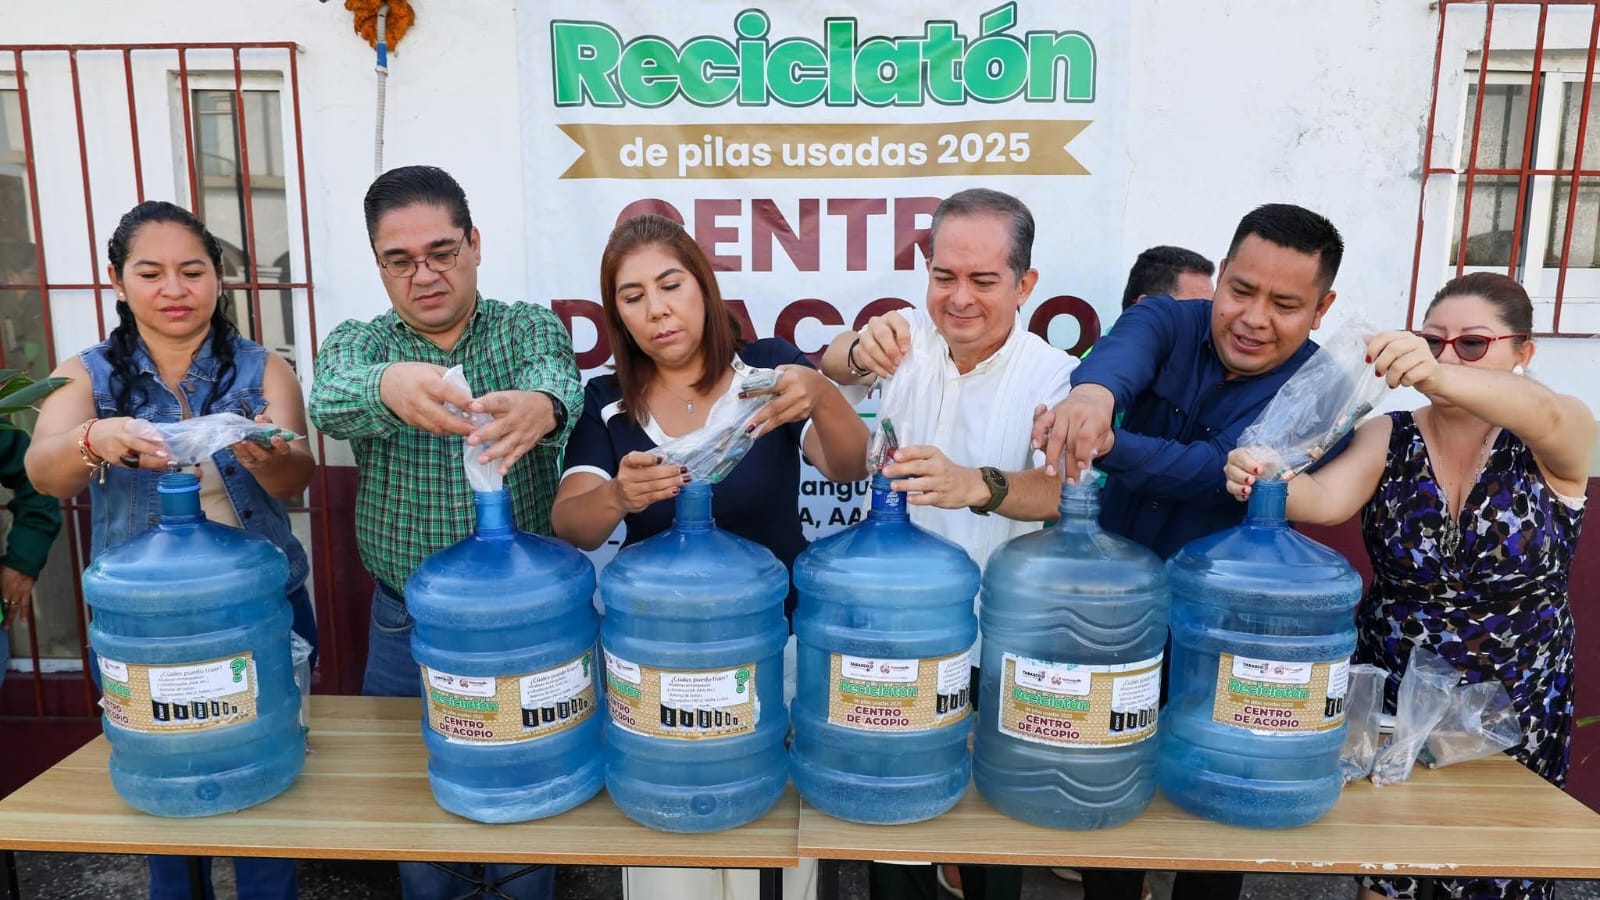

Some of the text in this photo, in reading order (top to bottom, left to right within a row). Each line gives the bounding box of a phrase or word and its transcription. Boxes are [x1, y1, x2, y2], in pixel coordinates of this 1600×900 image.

[550, 1, 1098, 108] Reciclatón
[619, 131, 1031, 177] de pilas usadas 2025
[615, 197, 944, 272] ENTR
[840, 679, 918, 698] Reciclatón
[1228, 678, 1310, 699] Reciclatón
[1012, 687, 1090, 712] Reciclatón
[855, 706, 901, 716] CENTRO
[1244, 706, 1292, 718] CENTRO
[444, 716, 484, 729] CENTRO
[847, 714, 909, 726] DE ACOPIO
[1026, 715, 1072, 729] CENTRO
[1234, 714, 1250, 723] DE
[1254, 718, 1299, 728] ACOPIO
[439, 722, 493, 738] DE ACOPIO
[1018, 722, 1032, 732] DE
[1035, 726, 1080, 740] ACOPIO
